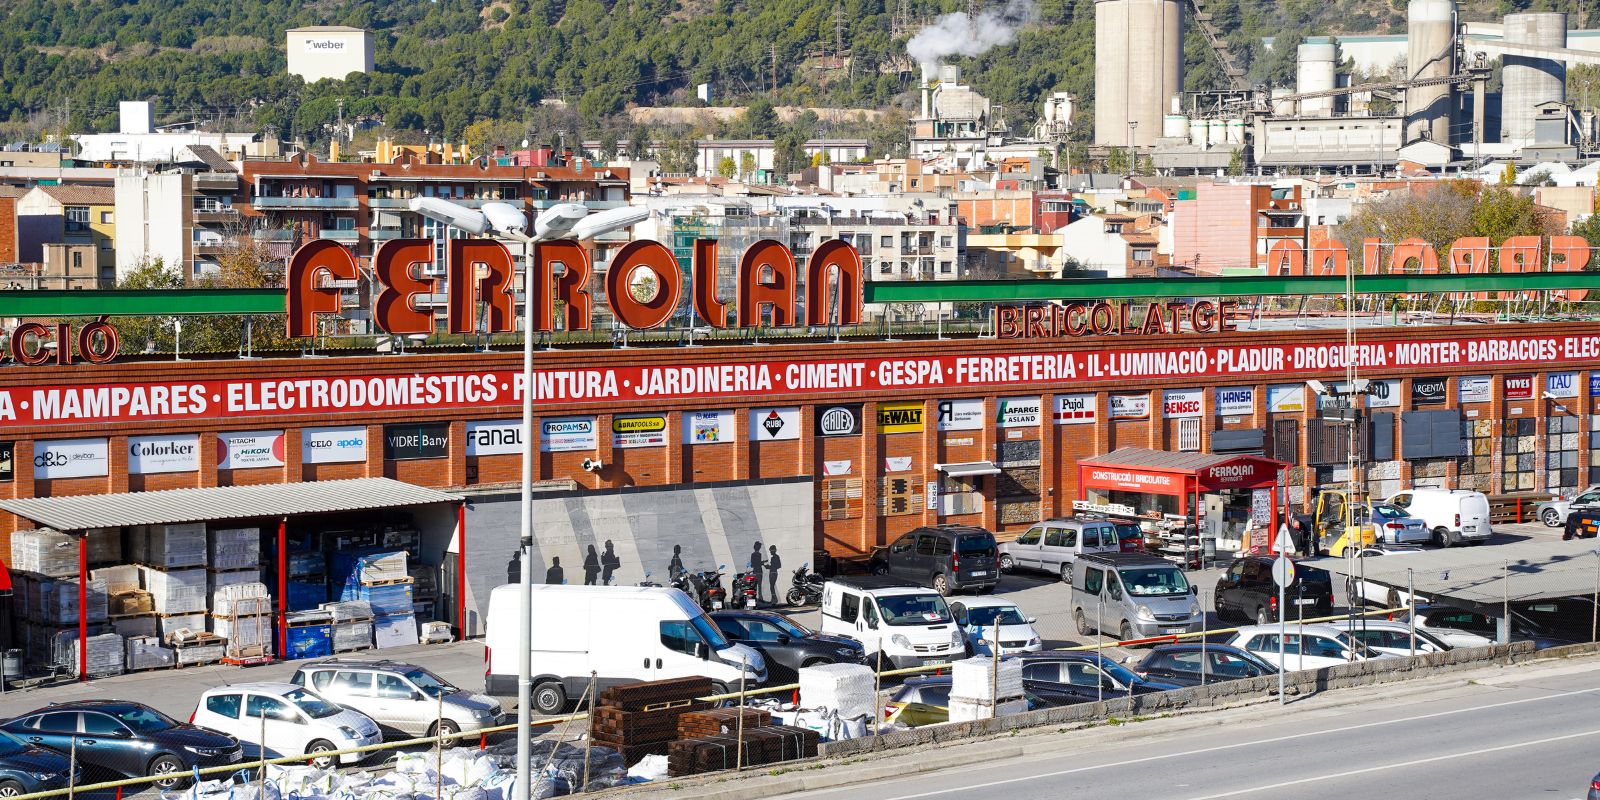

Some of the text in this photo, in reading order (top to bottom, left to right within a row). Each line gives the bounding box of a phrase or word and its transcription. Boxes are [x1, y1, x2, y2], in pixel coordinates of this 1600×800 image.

[313, 40, 344, 49] weber
[286, 238, 863, 338] FERROLAN
[995, 301, 1239, 339] BRICOLATGE
[0, 315, 119, 366] CIÓ
[32, 384, 207, 420] MAMPARES
[227, 373, 498, 412] ELECTRODOMÈSTICS
[513, 370, 619, 401] PINTURA
[634, 364, 772, 396] JARDINERIA
[785, 362, 865, 390] CIMENT
[878, 360, 944, 386] GESPA
[956, 354, 1077, 383] FERRETERIA
[1216, 348, 1285, 372] PLADUR
[1294, 345, 1387, 369] DROGUERIA
[1395, 342, 1460, 365] MORTER
[1467, 340, 1557, 362] BARBACOES
[1564, 337, 1600, 358] ELEC
[1506, 379, 1530, 389] VIVES
[1549, 375, 1572, 389] TAU
[1412, 382, 1446, 394] ARGENTA
[1062, 397, 1084, 411] Pujol
[1222, 391, 1252, 403] HANSA
[1004, 406, 1039, 415] LAFARGE
[1164, 400, 1200, 413] BENSEC
[766, 420, 782, 428] RUBI
[823, 410, 852, 431] ARDEX
[547, 423, 590, 434] PROPAMSA
[130, 441, 194, 457] Colorker
[310, 437, 363, 449] CELO apolo
[388, 435, 448, 449] VIDRE Bany
[1092, 471, 1132, 482] CONSTRUCCIÓ
[1135, 474, 1170, 485] BRICOLATGE
[1209, 464, 1254, 478] FERROLAN
